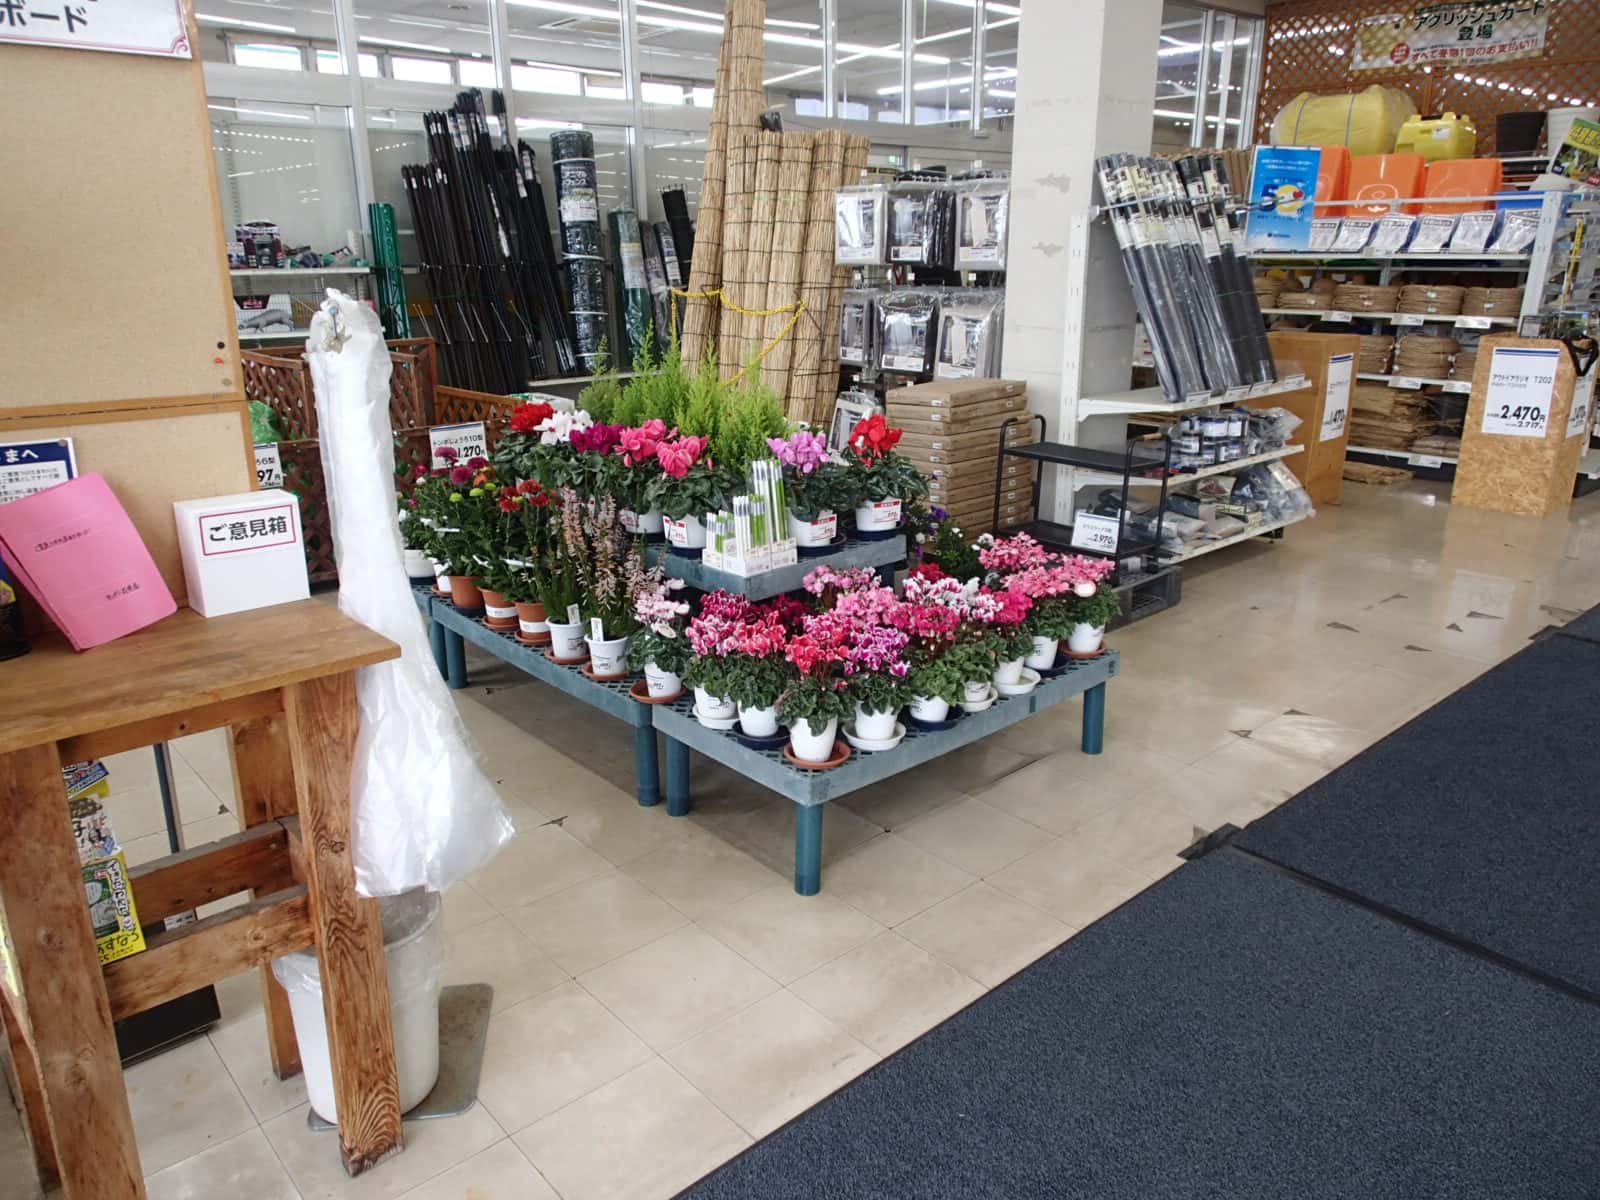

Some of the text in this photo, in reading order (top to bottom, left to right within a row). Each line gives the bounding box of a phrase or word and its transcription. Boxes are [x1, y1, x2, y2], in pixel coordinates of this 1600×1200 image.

[0, 0, 87, 33] ボード
[1457, 24, 1493, 41] 登場
[1534, 375, 1553, 384] T202
[3, 448, 39, 463] まへ
[209, 515, 288, 542] ご意見箱
